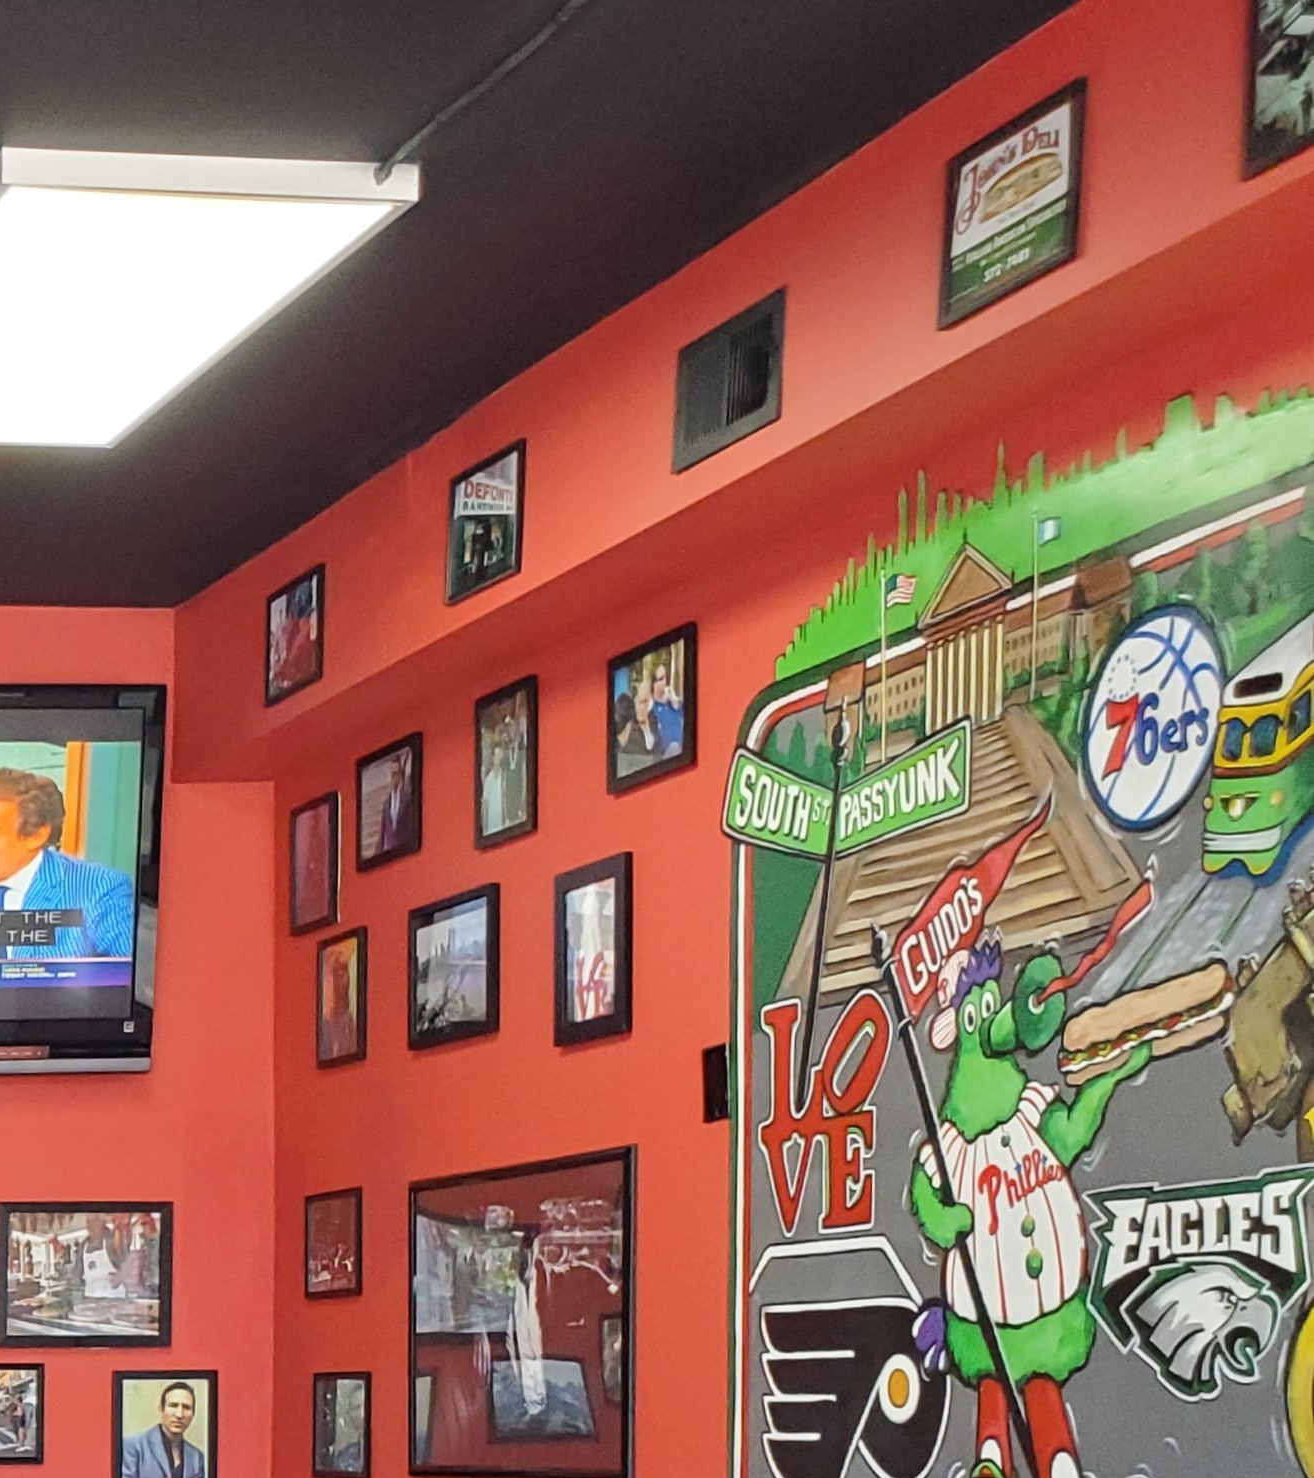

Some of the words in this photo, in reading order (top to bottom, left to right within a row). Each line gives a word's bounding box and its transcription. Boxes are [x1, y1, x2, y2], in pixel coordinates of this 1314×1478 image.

[1021, 126, 1060, 156] DELI
[1101, 692, 1209, 781] 76ers
[735, 764, 812, 841] SOUTH
[839, 738, 960, 841] PASSYUNK
[7, 930, 48, 943] THE
[22, 911, 62, 925] THE
[901, 877, 982, 996] GUIDO'S
[977, 1149, 1068, 1234] Phillies
[1103, 1178, 1306, 1288] EAGLES
